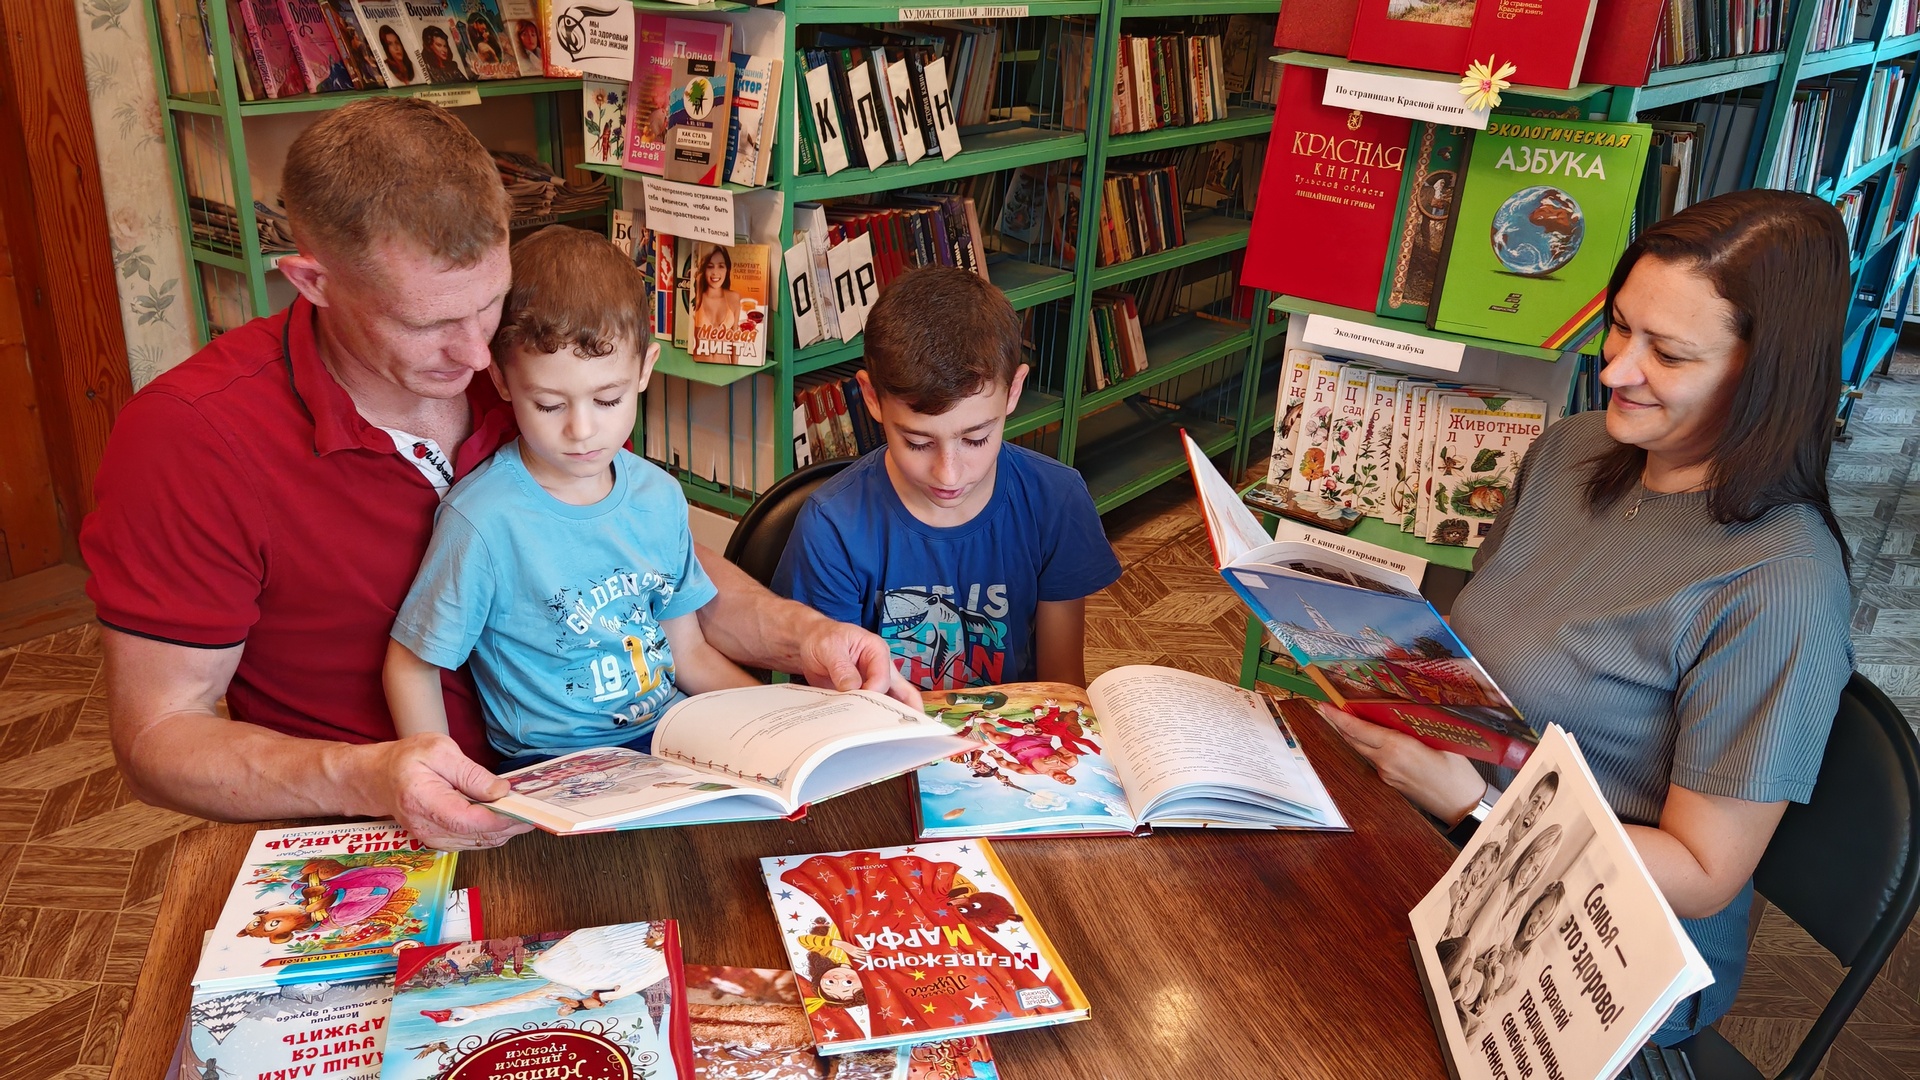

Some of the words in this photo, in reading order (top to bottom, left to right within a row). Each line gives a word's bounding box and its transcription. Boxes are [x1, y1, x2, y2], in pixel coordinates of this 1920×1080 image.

[589, 20, 600, 29] МЫ
[903, 7, 978, 19] ХУДОЖЕСТВЕННАЯ
[1496, 12, 1516, 20] СССР
[589, 28, 598, 36] ЗА
[598, 29, 629, 43] ЗДОРОВЫЙ
[590, 38, 608, 48] ОБРАЗ
[608, 41, 629, 51] ЖИЗНИ
[933, 88, 954, 131] Н
[1335, 85, 1347, 95] По
[1348, 89, 1395, 104] страницам
[1397, 95, 1435, 110] Красной
[1436, 102, 1465, 115] книги
[815, 98, 837, 144] К
[895, 88, 918, 136] М
[633, 135, 666, 152] Здоров
[1487, 122, 1632, 149] ЭКОЛОГИЧЕСКАЯ
[1291, 131, 1407, 172] КРАСНАЯ
[1494, 145, 1606, 180] АЗБУКА
[1295, 174, 1338, 190] Тульской
[1313, 162, 1371, 185] КНИГА
[1294, 188, 1342, 204] ЛИШАЙНИКИ
[1343, 198, 1349, 206] И
[1350, 199, 1376, 211] ГРИБЫ
[834, 268, 856, 314] П
[855, 262, 875, 307] Р
[698, 324, 758, 342] Медовая
[1333, 327, 1395, 349] Экологическая
[1396, 343, 1425, 355] азбука
[696, 340, 757, 358] ДИЕТА
[1448, 414, 1541, 436] Животные
[1303, 532, 1310, 542] Я
[1317, 539, 1346, 553] книгой
[1347, 546, 1388, 565] открываю
[1389, 559, 1407, 572] мир
[264, 830, 389, 850] МЕДВЕДЬ
[1582, 882, 1620, 950] Семья
[1559, 914, 1583, 951] это
[1572, 942, 1625, 1033] здорово!
[1537, 964, 1575, 1033] Сохраняй
[310, 1010, 360, 1025] Истории
[282, 1016, 386, 1046] ДРУЖИТЬ
[291, 1036, 376, 1062] УЧИТСЯ
[505, 1042, 568, 1059] гусями
[568, 1052, 577, 1060] с
[1481, 1031, 1509, 1080] ценност
[322, 1051, 384, 1074] АЛЫШ
[495, 1052, 563, 1070] дикими
